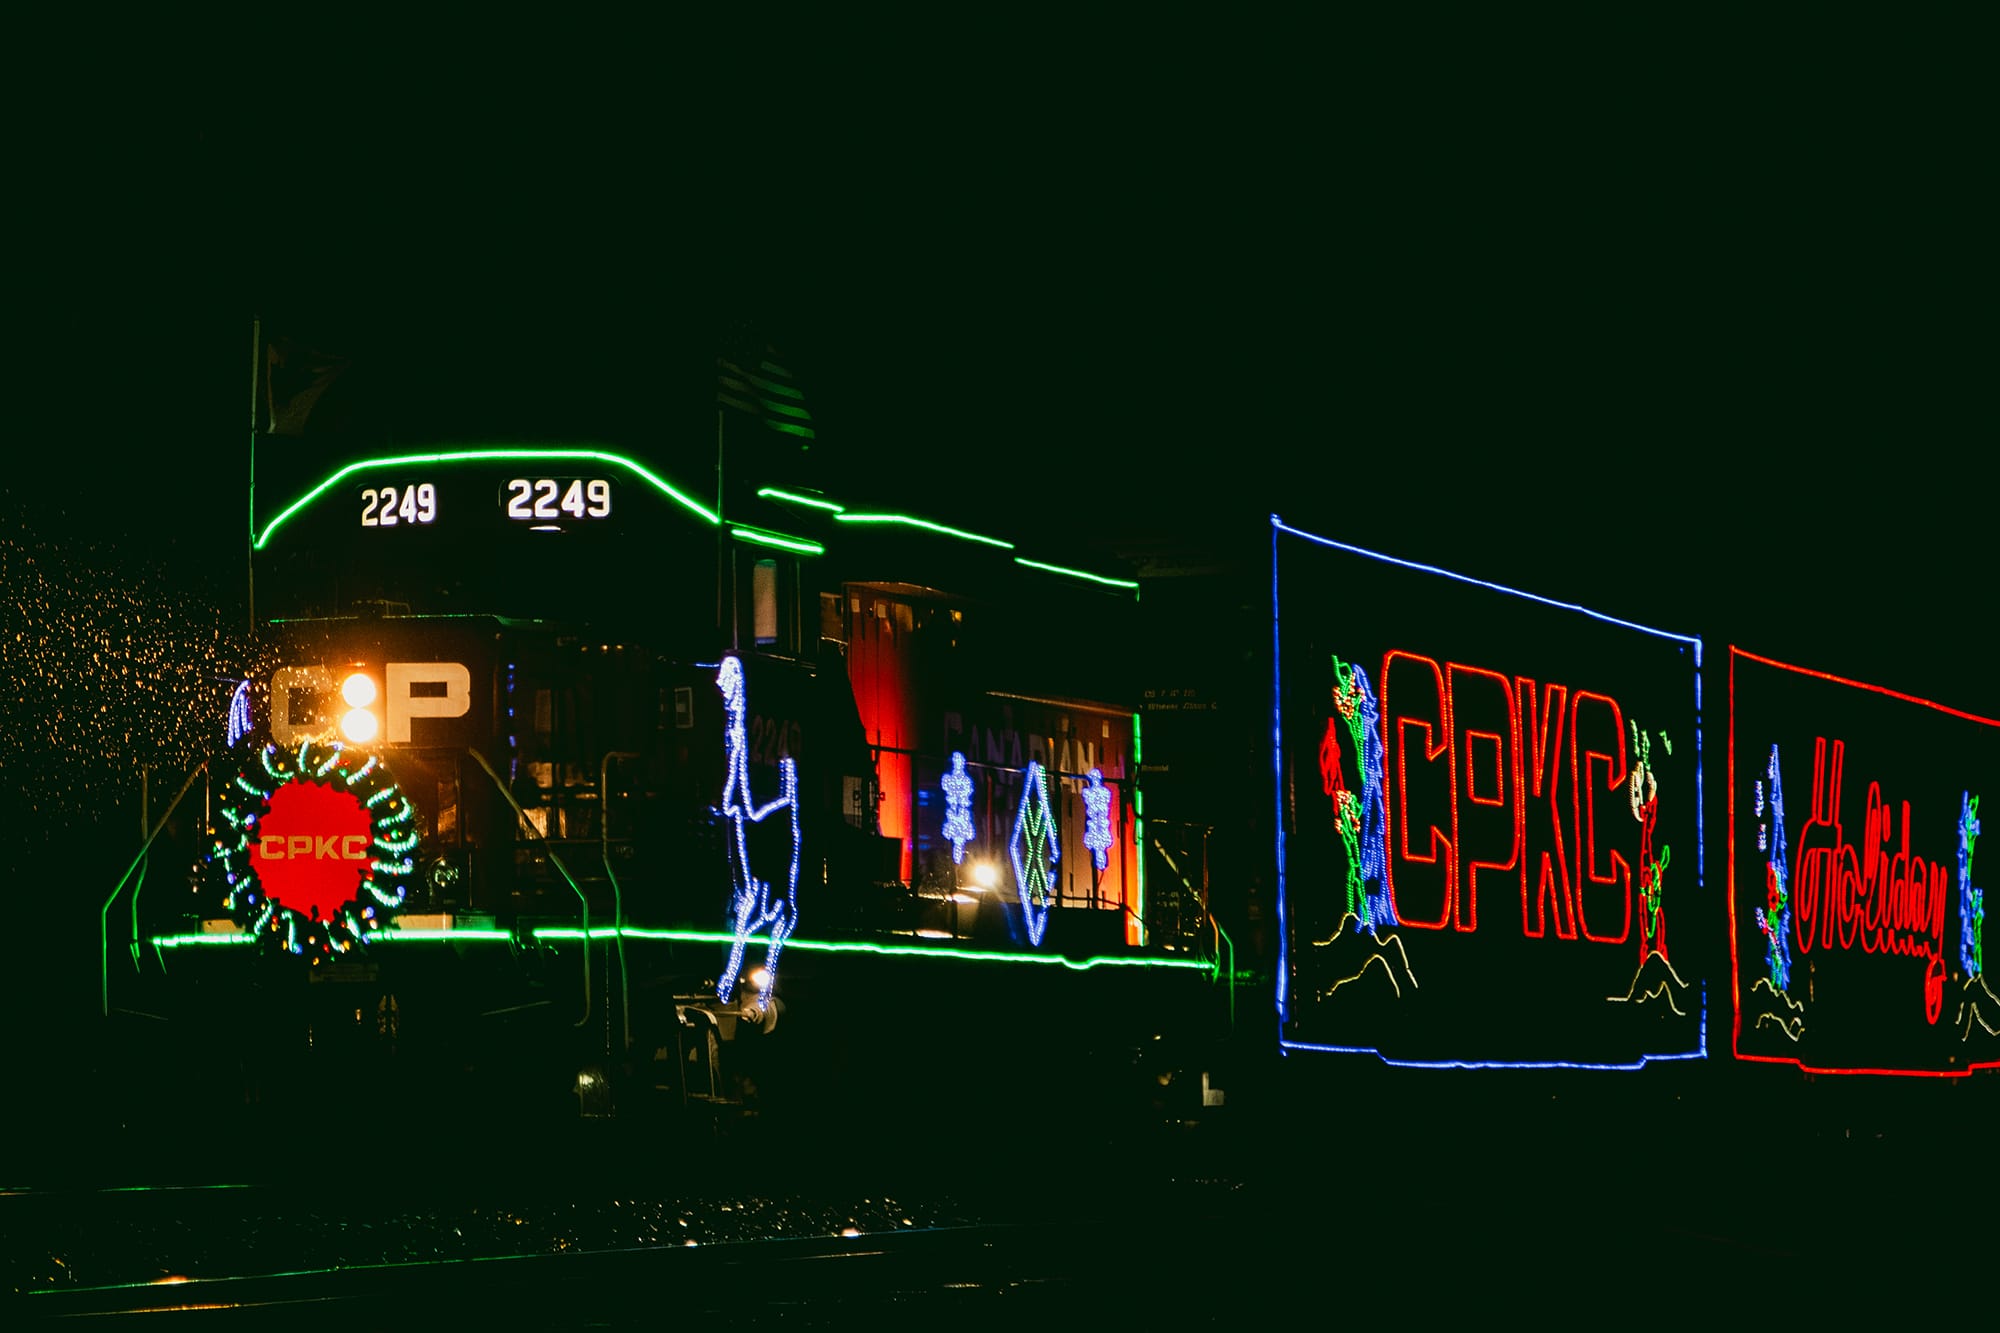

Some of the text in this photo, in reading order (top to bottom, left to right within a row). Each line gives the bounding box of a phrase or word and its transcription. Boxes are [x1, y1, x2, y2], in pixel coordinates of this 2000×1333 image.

[360, 482, 438, 527] 2249
[507, 479, 611, 519] 2249
[1380, 650, 1631, 944] CPKC
[258, 834, 368, 861] CPKC
[1795, 736, 1948, 1026] Holiday
